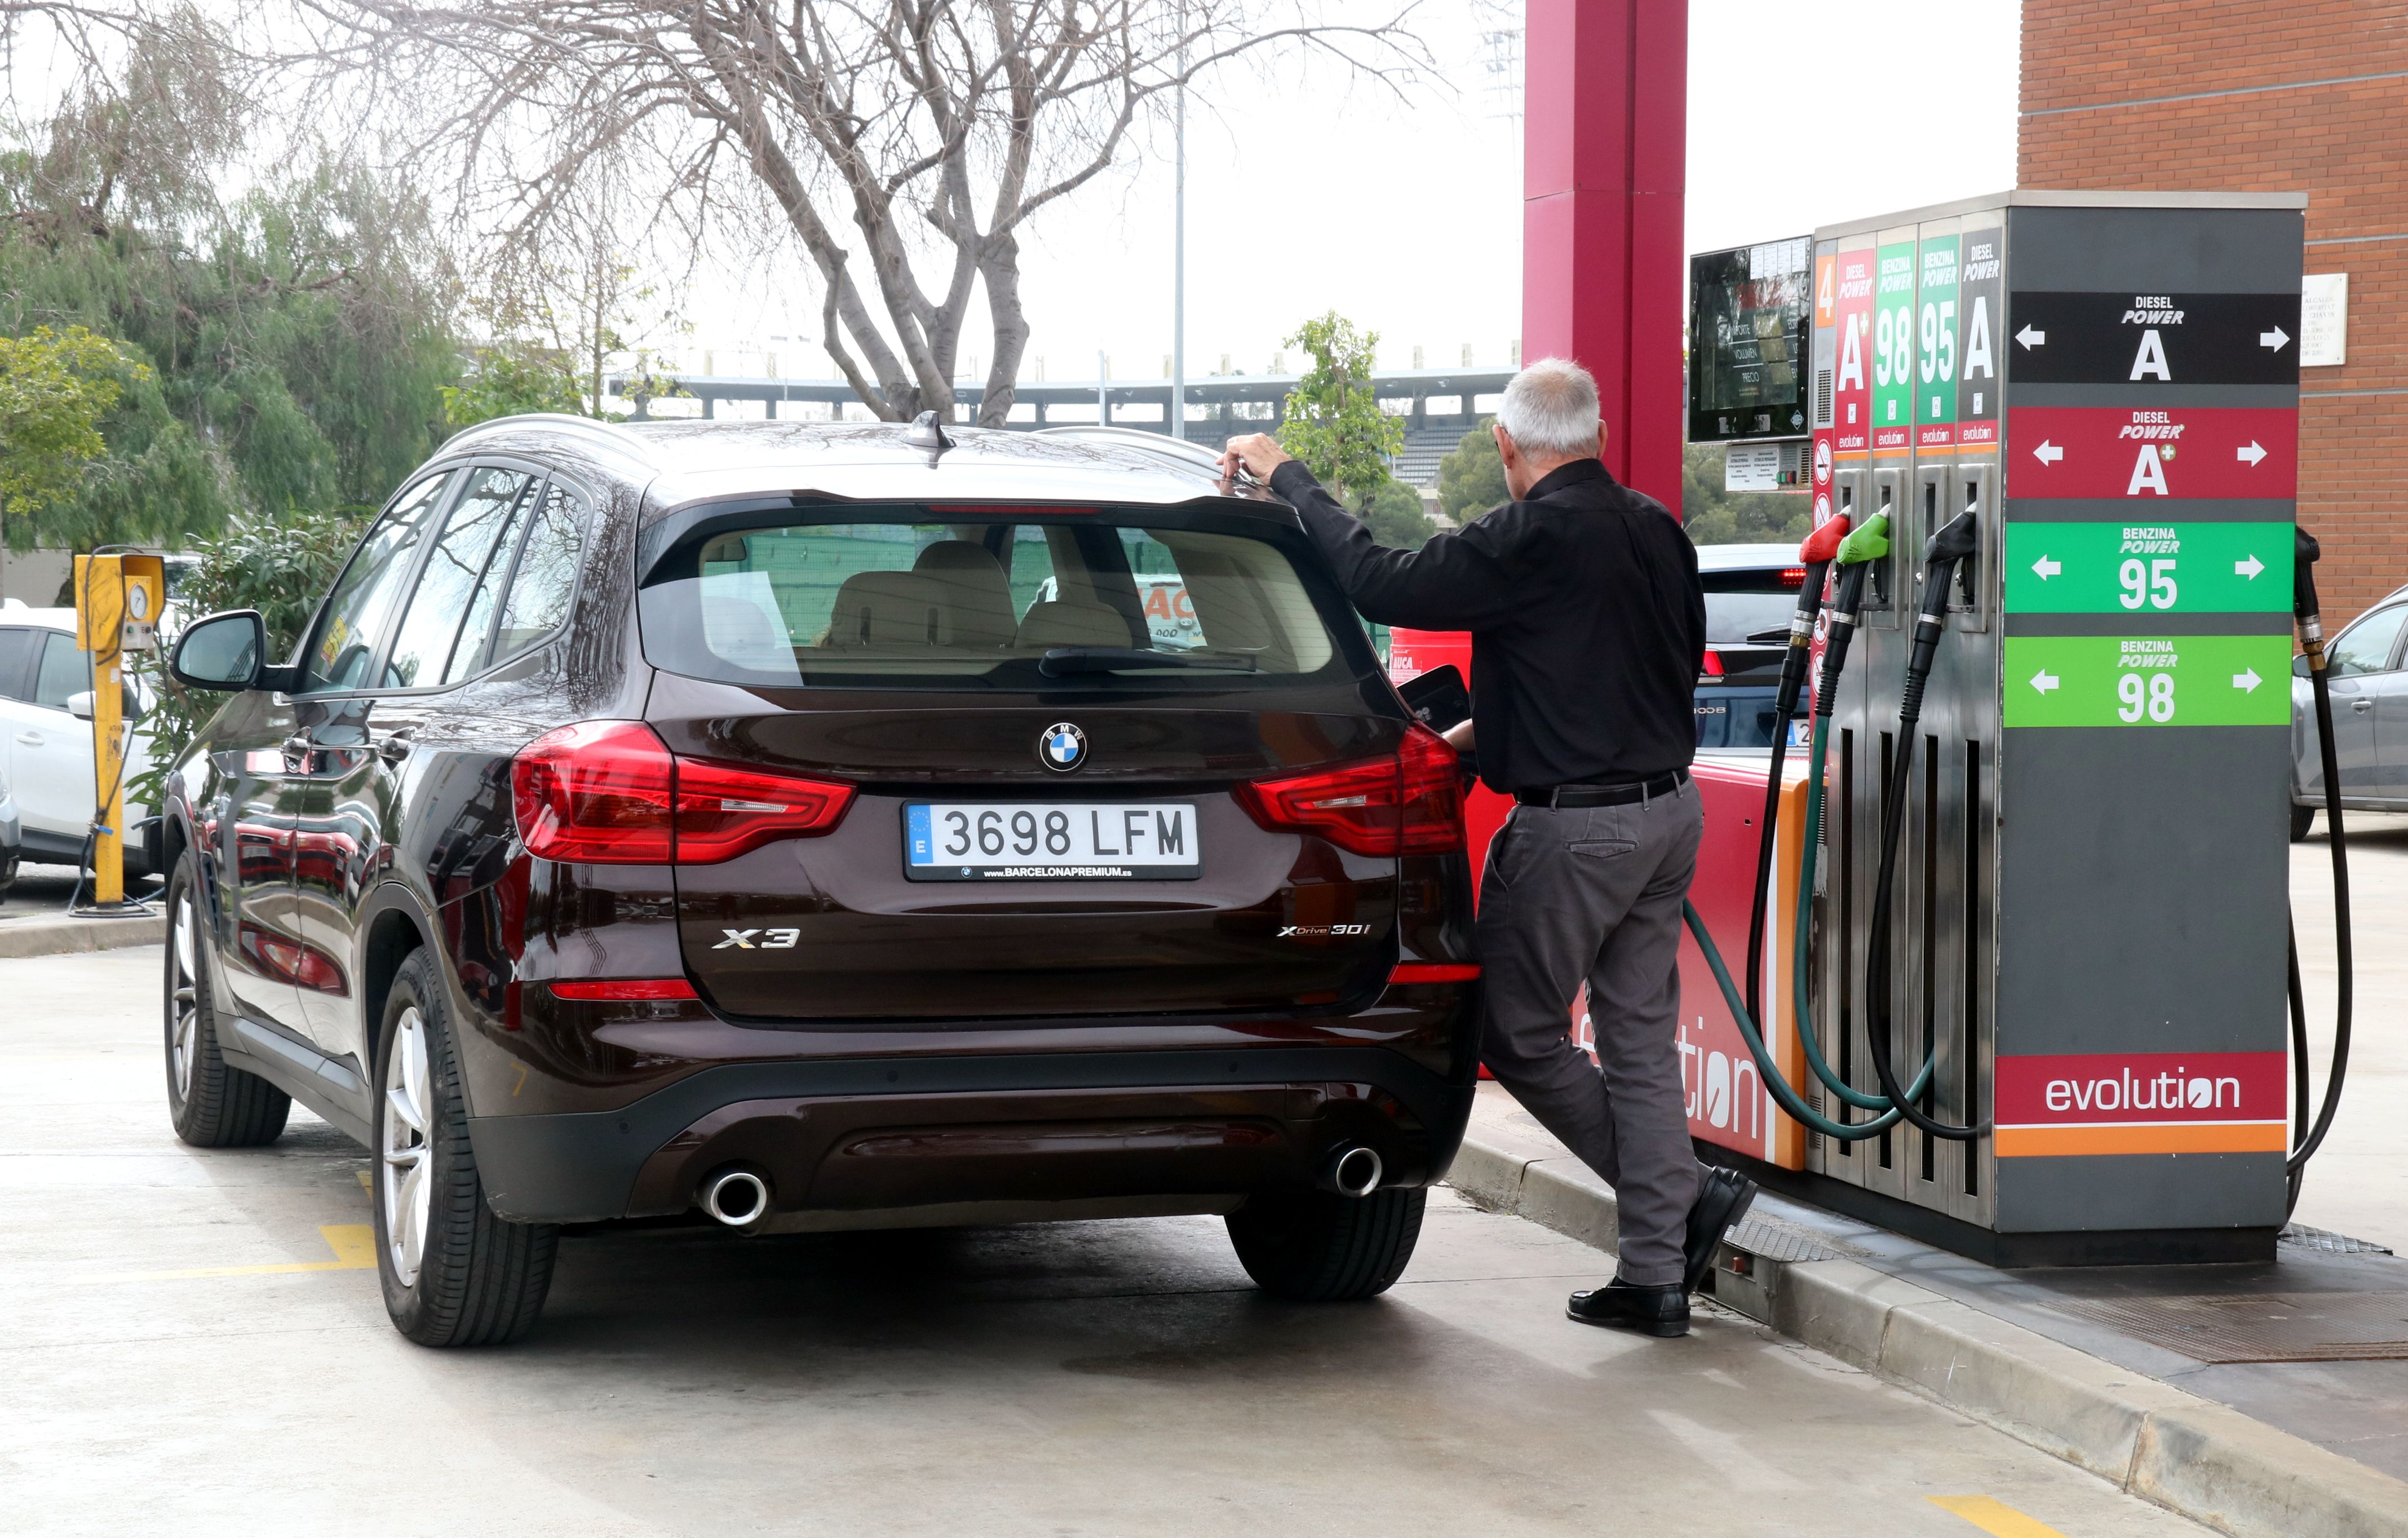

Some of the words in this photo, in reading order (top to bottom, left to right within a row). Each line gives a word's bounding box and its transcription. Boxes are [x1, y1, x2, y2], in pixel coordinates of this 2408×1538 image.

[1924, 249, 1955, 269] BENZINA
[1971, 243, 1993, 261] DIESEL
[1846, 264, 1865, 280] DIESEL
[1882, 256, 1910, 275] BENZINA
[1963, 259, 2000, 282] POWER
[1879, 272, 1913, 294] POWER
[1922, 266, 1957, 288] POWER
[1819, 263, 1833, 318] 4
[2136, 296, 2173, 308] DIESEL
[2121, 310, 2184, 324] POWER
[1876, 306, 1911, 387] 98
[1920, 300, 1954, 384] 95
[1964, 296, 1994, 380] A
[1733, 348, 1758, 360] VOLUMEN
[2130, 329, 2171, 381] A
[1742, 372, 1760, 383] PRECIO
[2133, 412, 2170, 423] DIESEL
[1839, 434, 1863, 448] evolution
[1878, 431, 1904, 445] evolution
[1922, 428, 1949, 443] evolution
[1963, 425, 1991, 440] evolution
[2123, 528, 2176, 540] BENZINA
[2119, 540, 2180, 554] POWER
[2119, 559, 2177, 609] 95
[2121, 640, 2174, 652] BENZINA
[2117, 654, 2178, 668] POWER
[2118, 673, 2175, 723] 98
[1046, 724, 1083, 741] BMW
[915, 840, 926, 854] E
[945, 810, 1071, 856] 3698
[1091, 810, 1184, 856] LFM
[711, 929, 800, 949] X3
[2046, 1066, 2240, 1111] evolution
